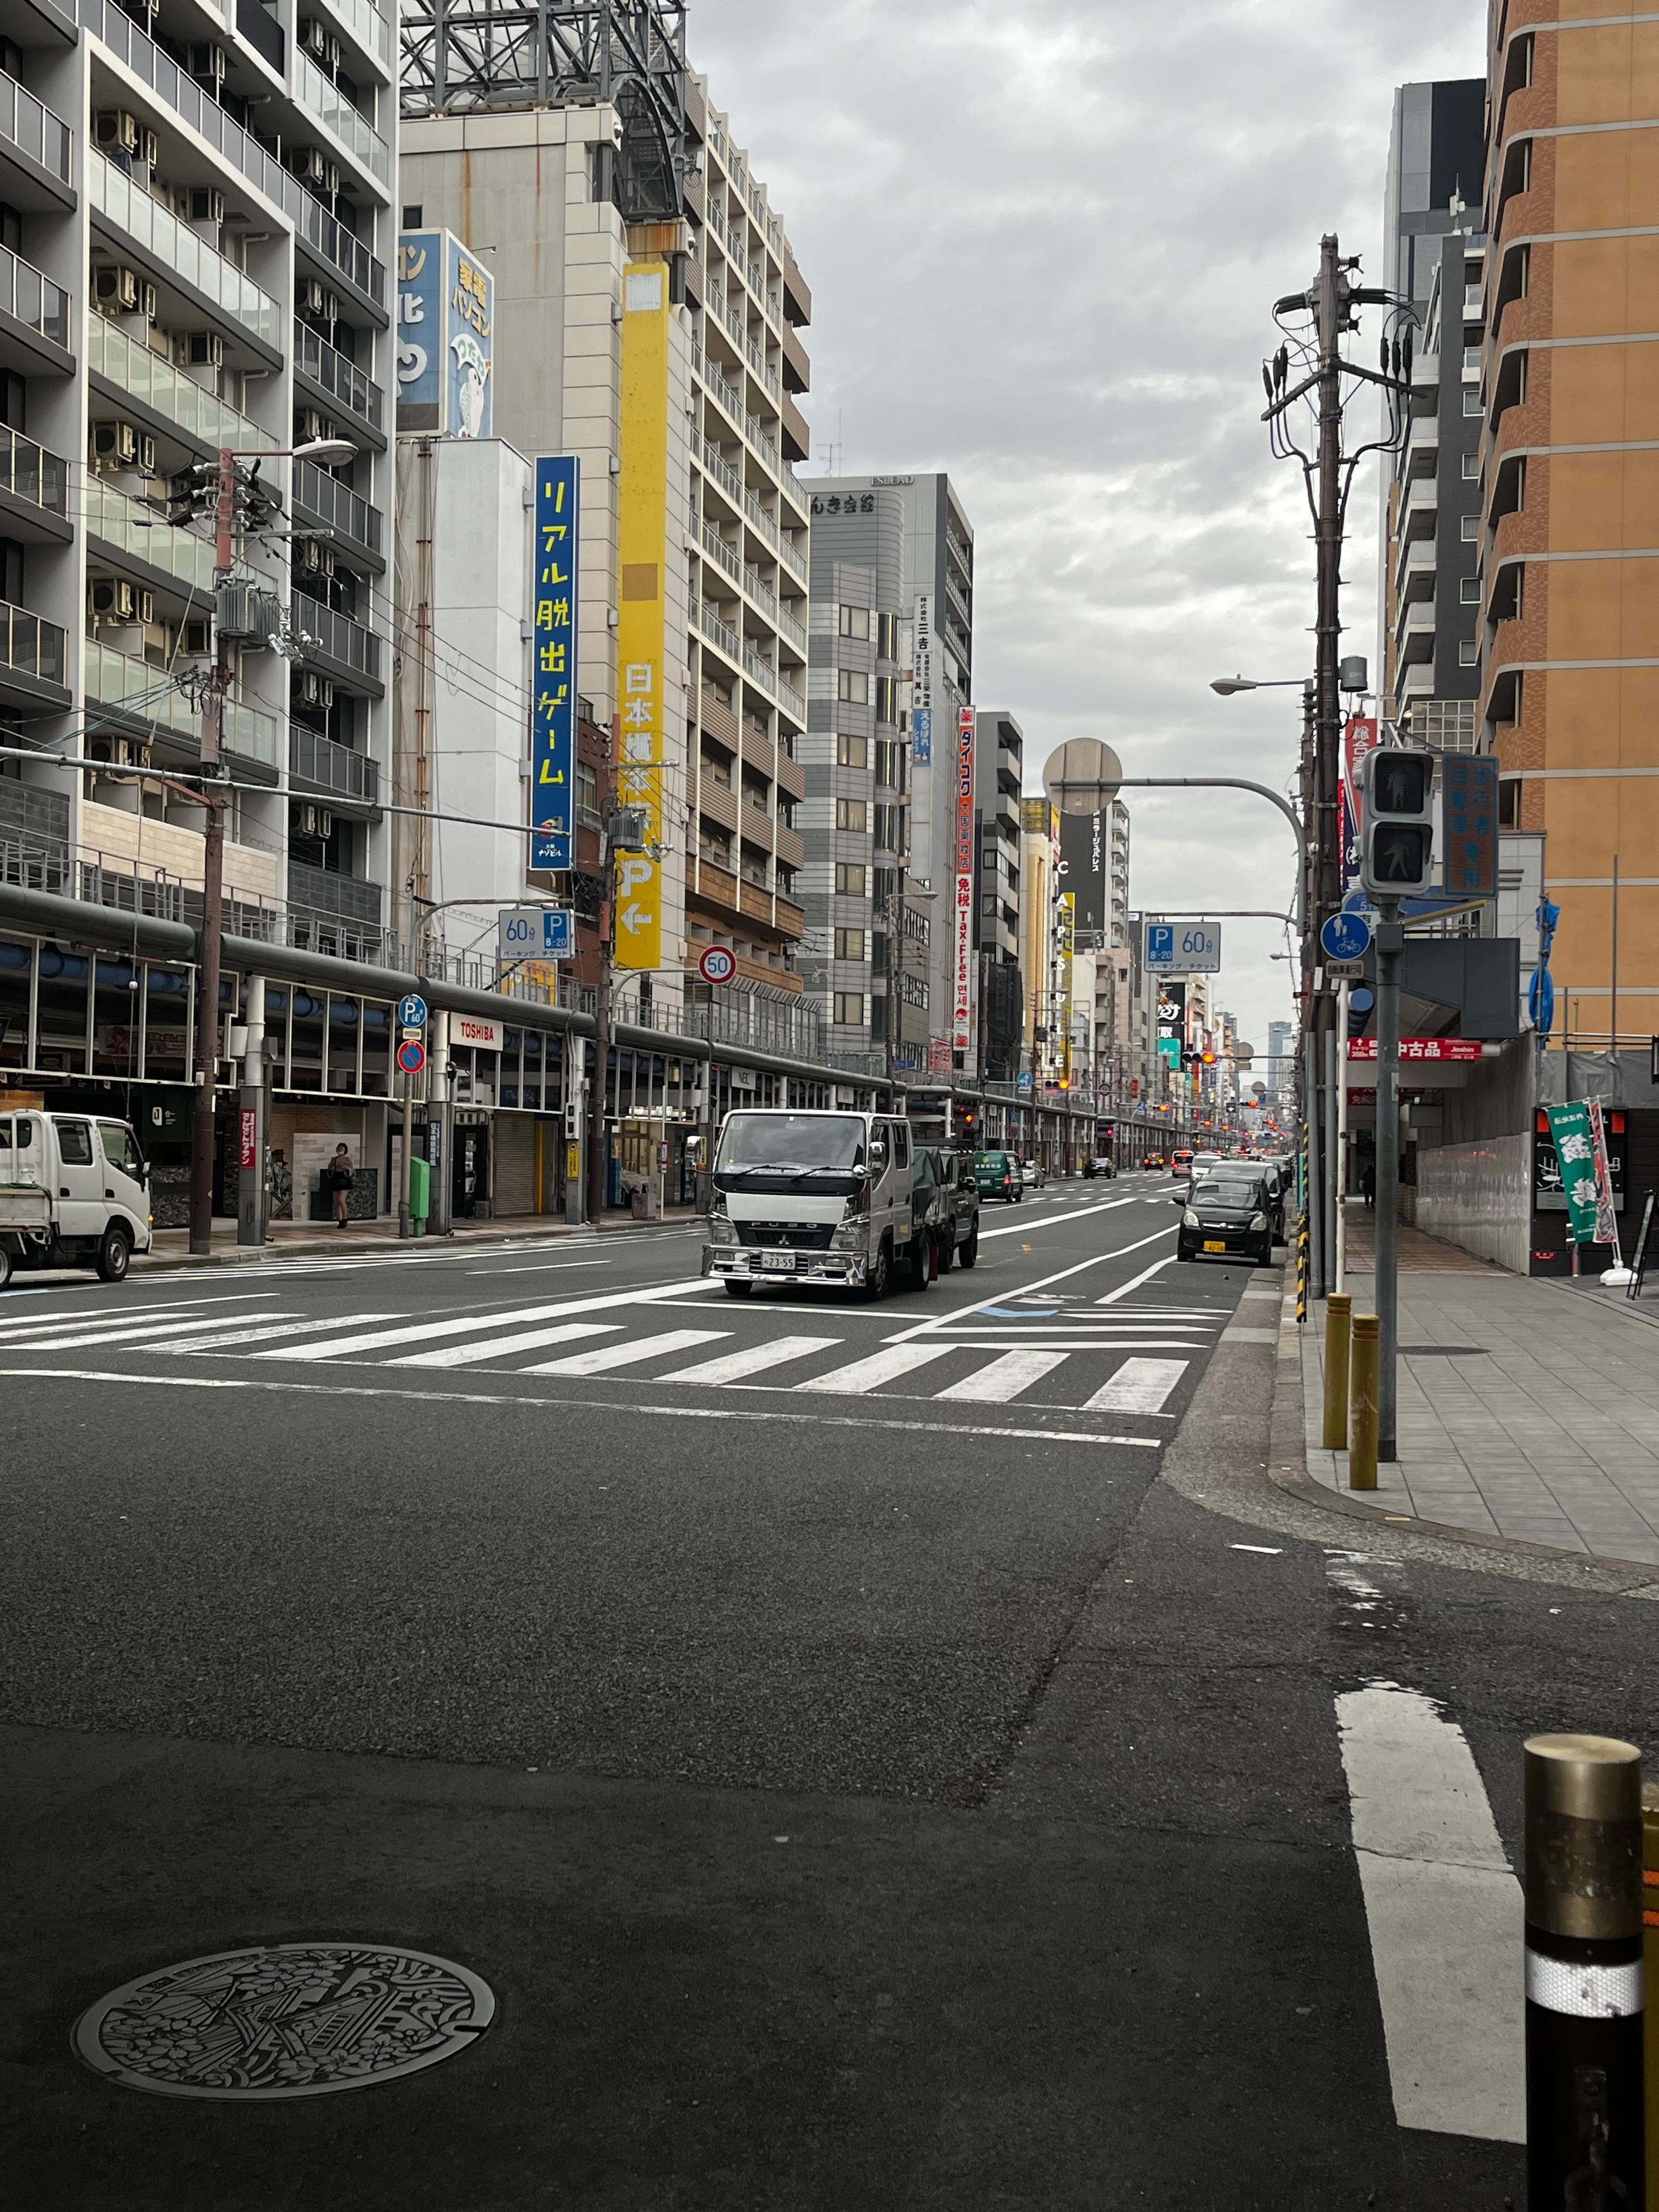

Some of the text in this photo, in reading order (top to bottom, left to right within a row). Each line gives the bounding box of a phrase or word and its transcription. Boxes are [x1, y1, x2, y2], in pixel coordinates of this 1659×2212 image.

[452, 285, 492, 338] パソコン
[870, 475, 915, 487] ESLEAD
[535, 482, 570, 785] リアル脱出ゲーム
[961, 730, 972, 797] ダイコク
[621, 859, 653, 897] P
[957, 877, 970, 907] 免税
[506, 919, 535, 941] 60分
[550, 915, 562, 935] P
[545, 938, 567, 947] 8-20
[1155, 929, 1169, 949] P
[1182, 932, 1213, 953] 60分
[707, 956, 727, 973] 50
[1054, 860, 1069, 1067] CAPSULE
[1150, 951, 1172, 960] 8-20
[405, 1002, 416, 1022] P
[460, 1022, 494, 1042] TOSHIBA
